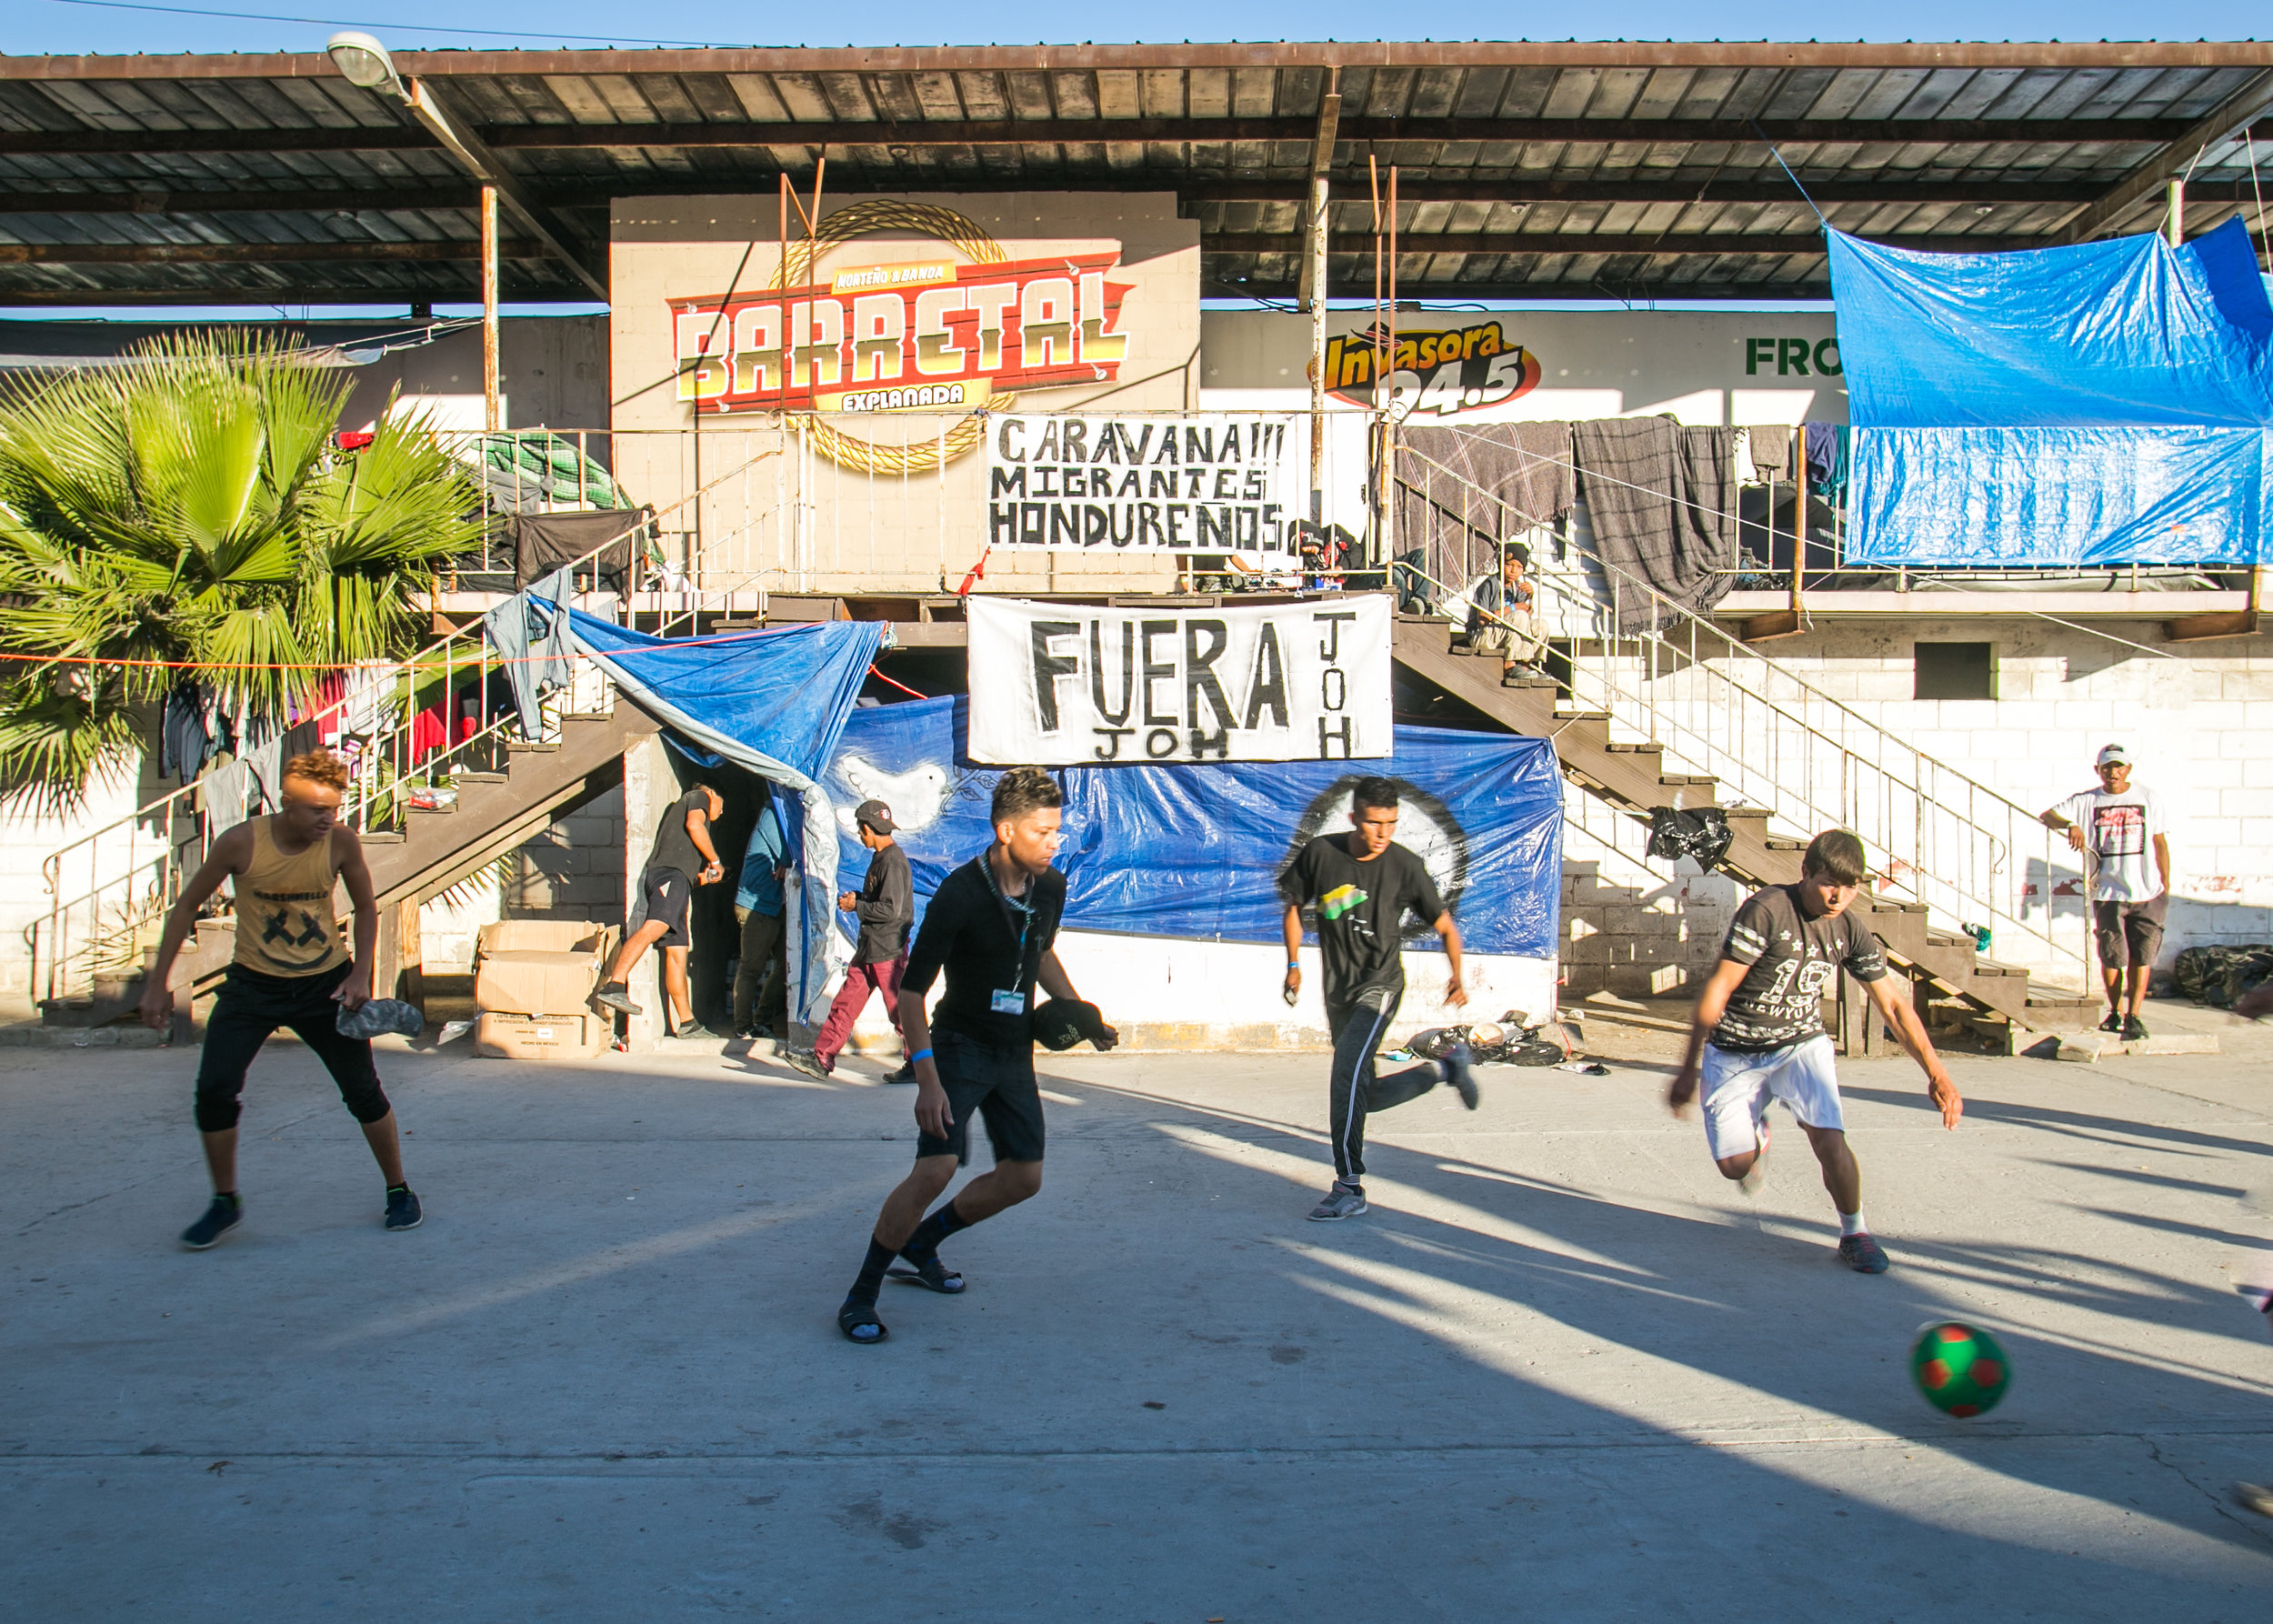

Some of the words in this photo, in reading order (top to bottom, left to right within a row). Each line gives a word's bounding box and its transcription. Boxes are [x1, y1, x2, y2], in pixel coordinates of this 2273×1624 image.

[836, 266, 888, 288] NORTEÑO
[900, 266, 944, 283] BANDA
[676, 272, 1128, 401] BARRETAL
[1324, 323, 1501, 389] Invasora
[841, 384, 966, 412] EXPLANADA
[999, 418, 1286, 466] CARAVANA!!!
[991, 466, 1267, 500] MIGRANTES
[1030, 619, 1289, 733] FUERA
[1313, 612, 1357, 759] JOH
[1093, 727, 1229, 760] JOH
